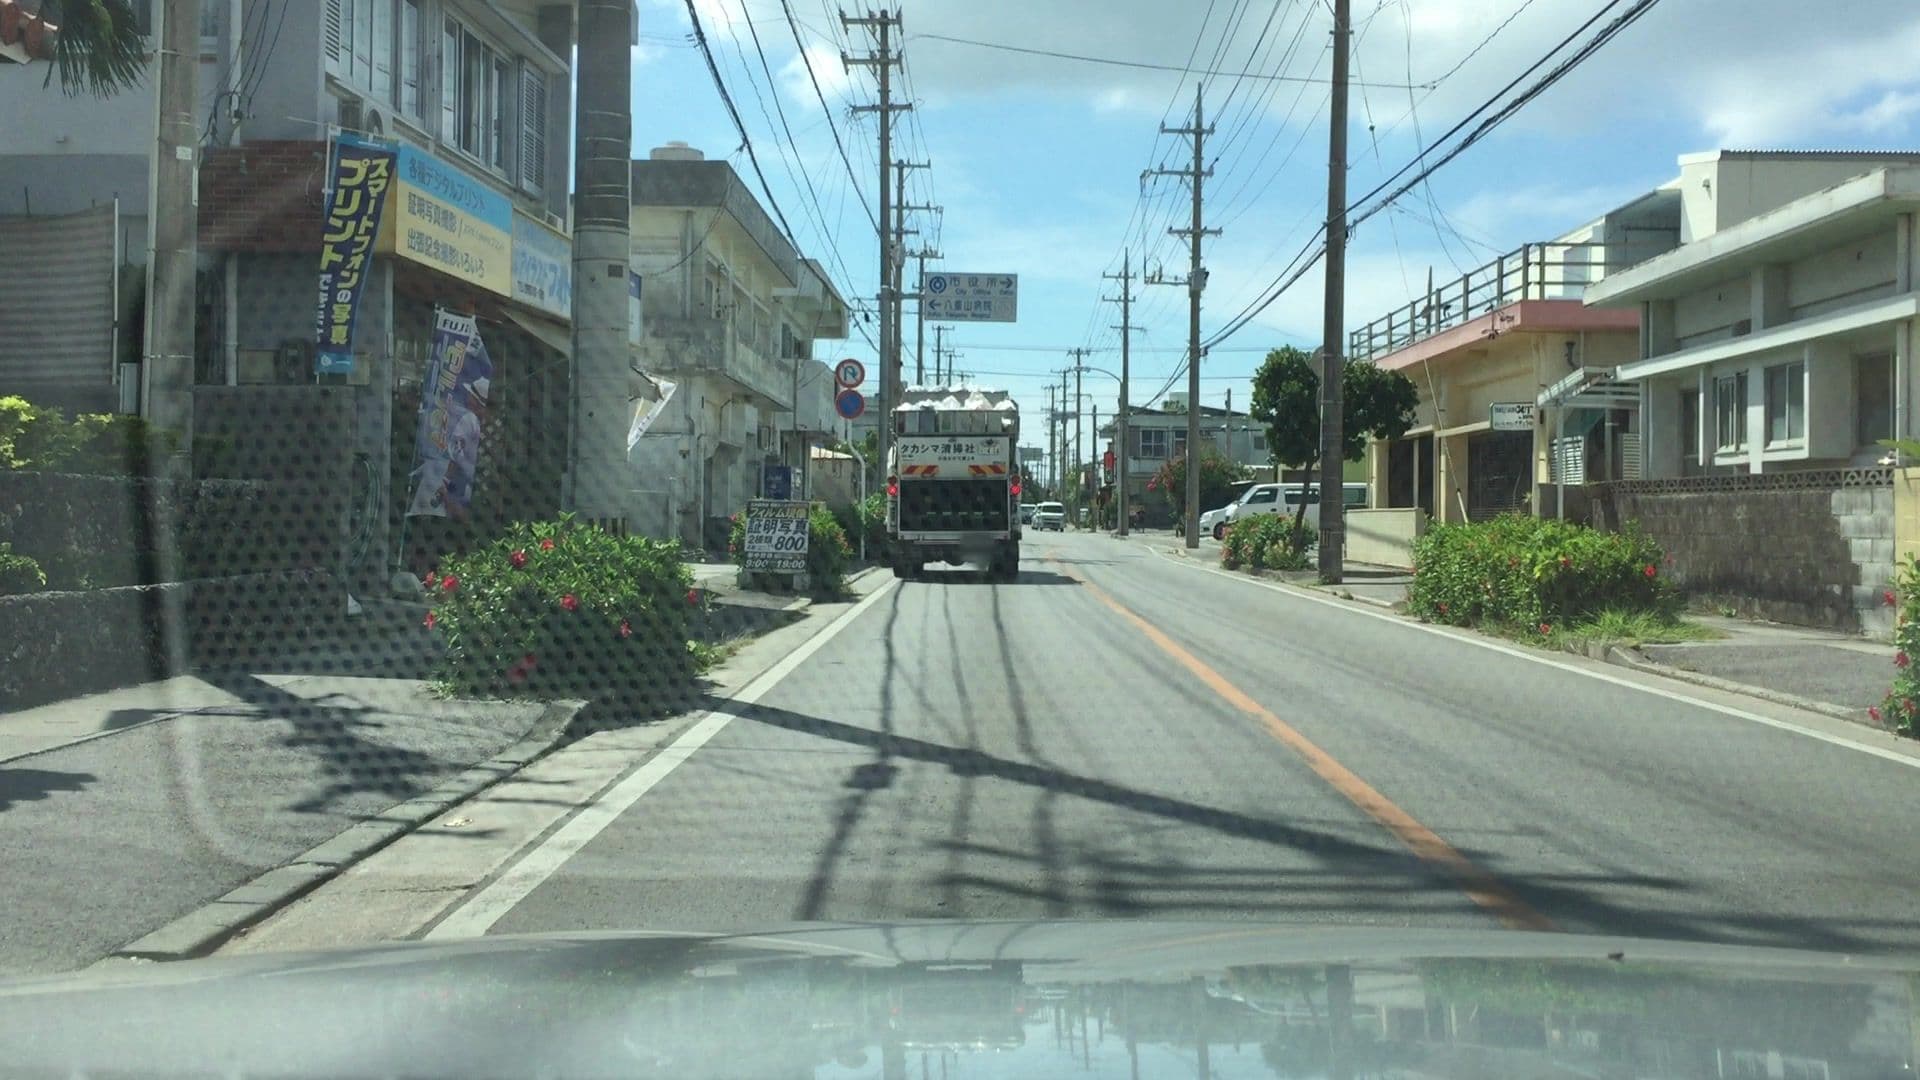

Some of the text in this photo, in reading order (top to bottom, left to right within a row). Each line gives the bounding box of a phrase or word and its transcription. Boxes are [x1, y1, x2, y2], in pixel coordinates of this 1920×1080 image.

[331, 158, 389, 345] スマートフォンの写真
[747, 519, 808, 535] 証明写真
[774, 535, 805, 551] 800
[745, 559, 769, 568] 9:00
